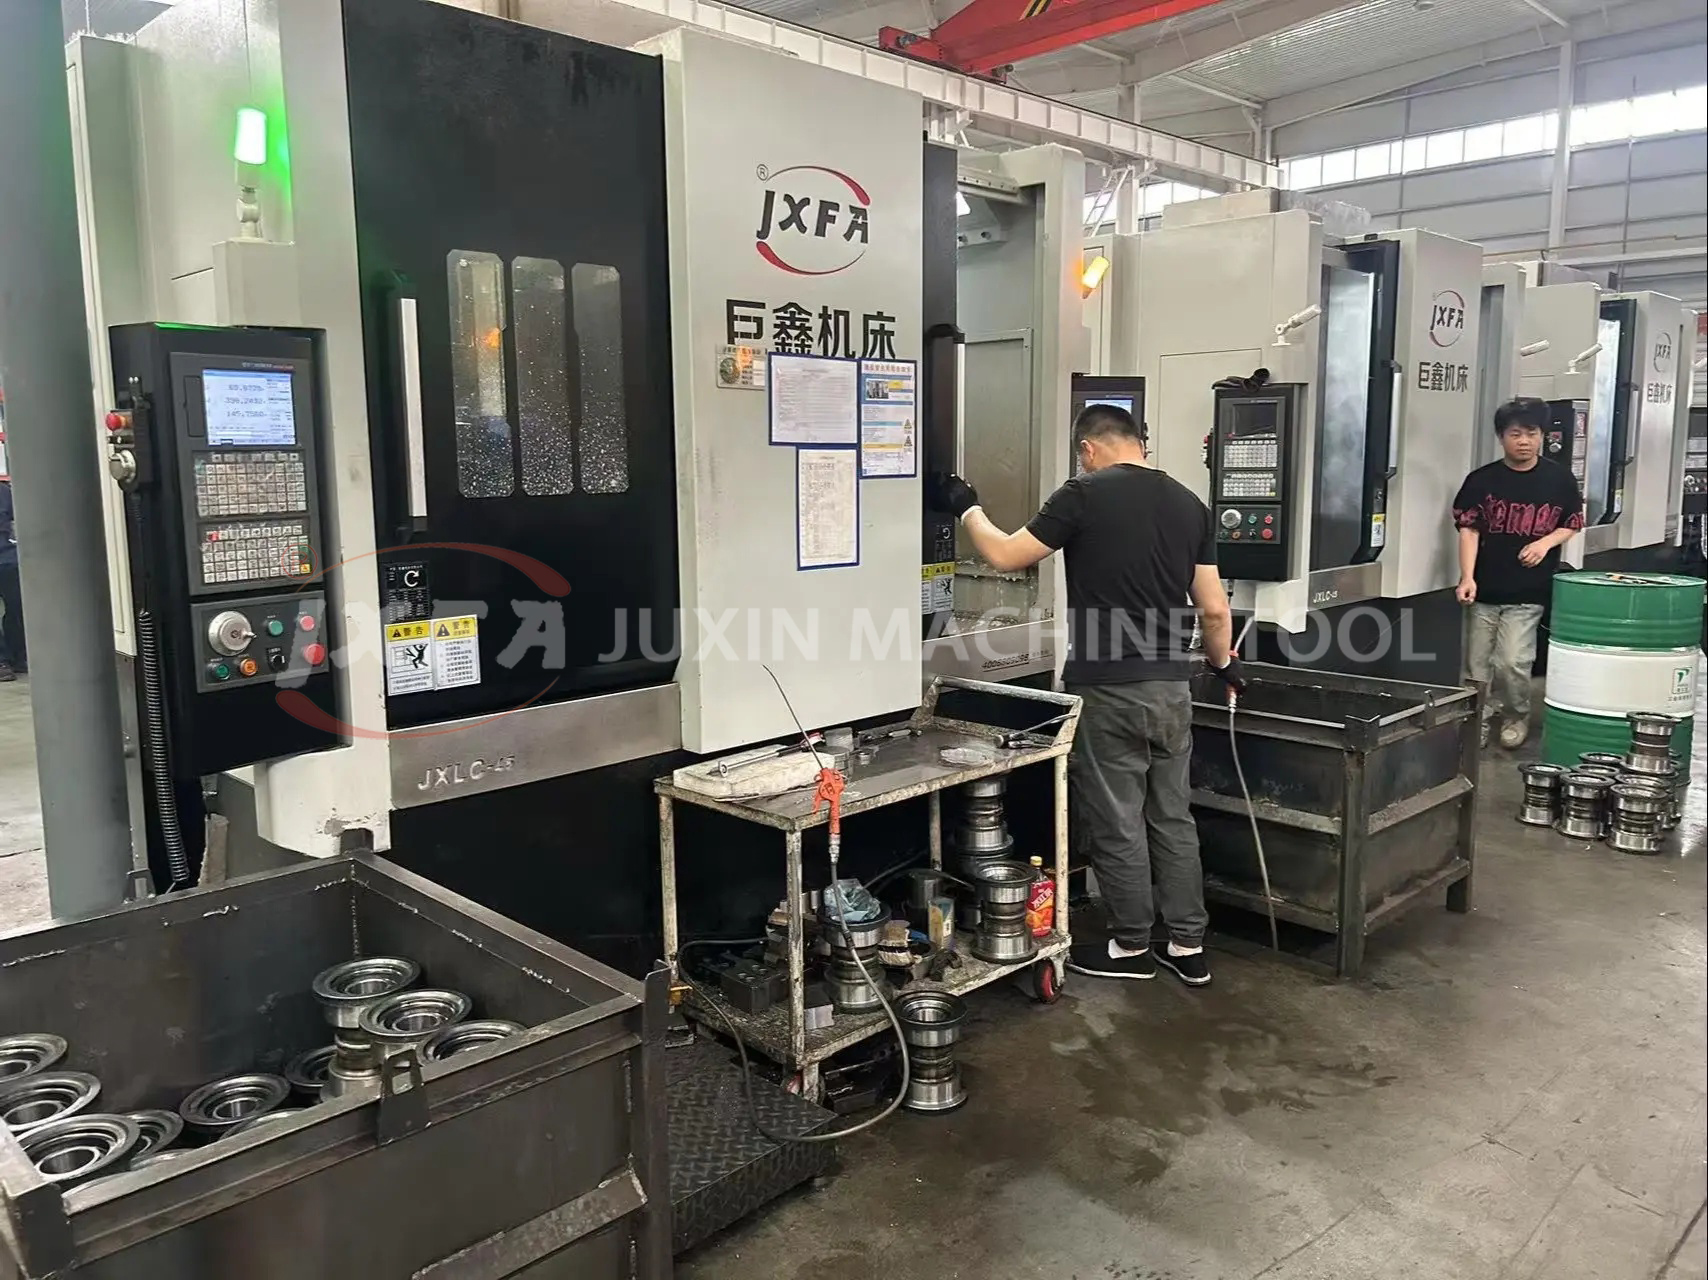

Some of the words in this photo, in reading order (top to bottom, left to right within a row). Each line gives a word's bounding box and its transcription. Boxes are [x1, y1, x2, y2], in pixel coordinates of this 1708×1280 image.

[756, 189, 869, 244] JXFA
[726, 299, 896, 359] 巨鑫机床
[1430, 304, 1464, 330] JXFA
[1418, 361, 1469, 392] 巨鑫机床
